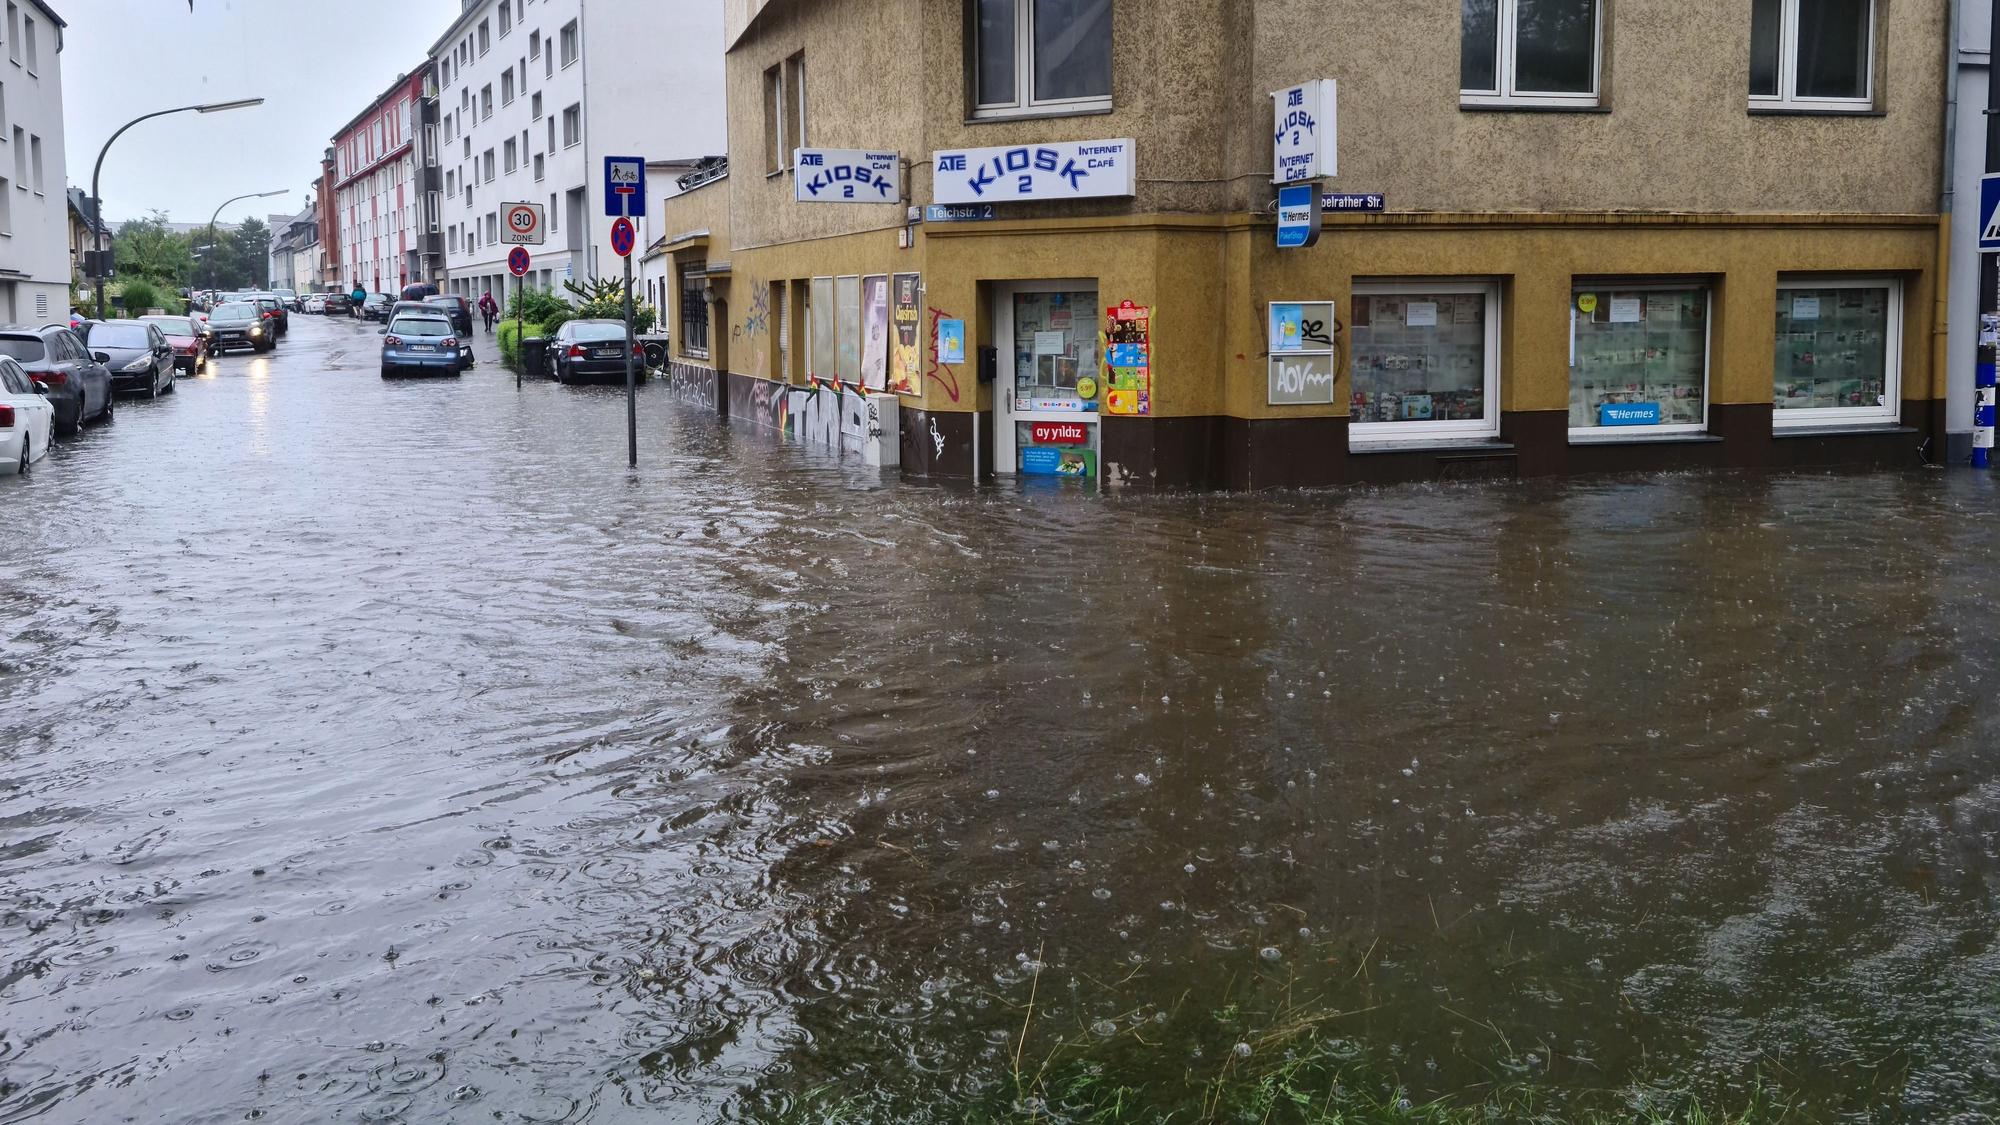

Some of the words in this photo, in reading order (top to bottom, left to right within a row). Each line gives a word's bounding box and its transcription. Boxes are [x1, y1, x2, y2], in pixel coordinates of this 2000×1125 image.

[1288, 88, 1303, 108] ATE
[1275, 111, 1316, 145] KIOSK
[1293, 131, 1300, 146] 2
[800, 154, 823, 166] ATE
[938, 155, 966, 171] ATE
[967, 148, 1090, 197] KIOSK
[806, 165, 893, 198] KIOSK
[1018, 175, 1033, 194] 2
[843, 185, 854, 198] 2
[1367, 196, 1383, 208] Str.
[931, 207, 976, 218] Teichstr.
[983, 205, 992, 218] 2
[1287, 211, 1310, 222] Hermes
[514, 213, 531, 226] 30
[511, 234, 533, 242] ZONE
[1618, 410, 1654, 419] Hermes
[1036, 427, 1050, 440] ay
